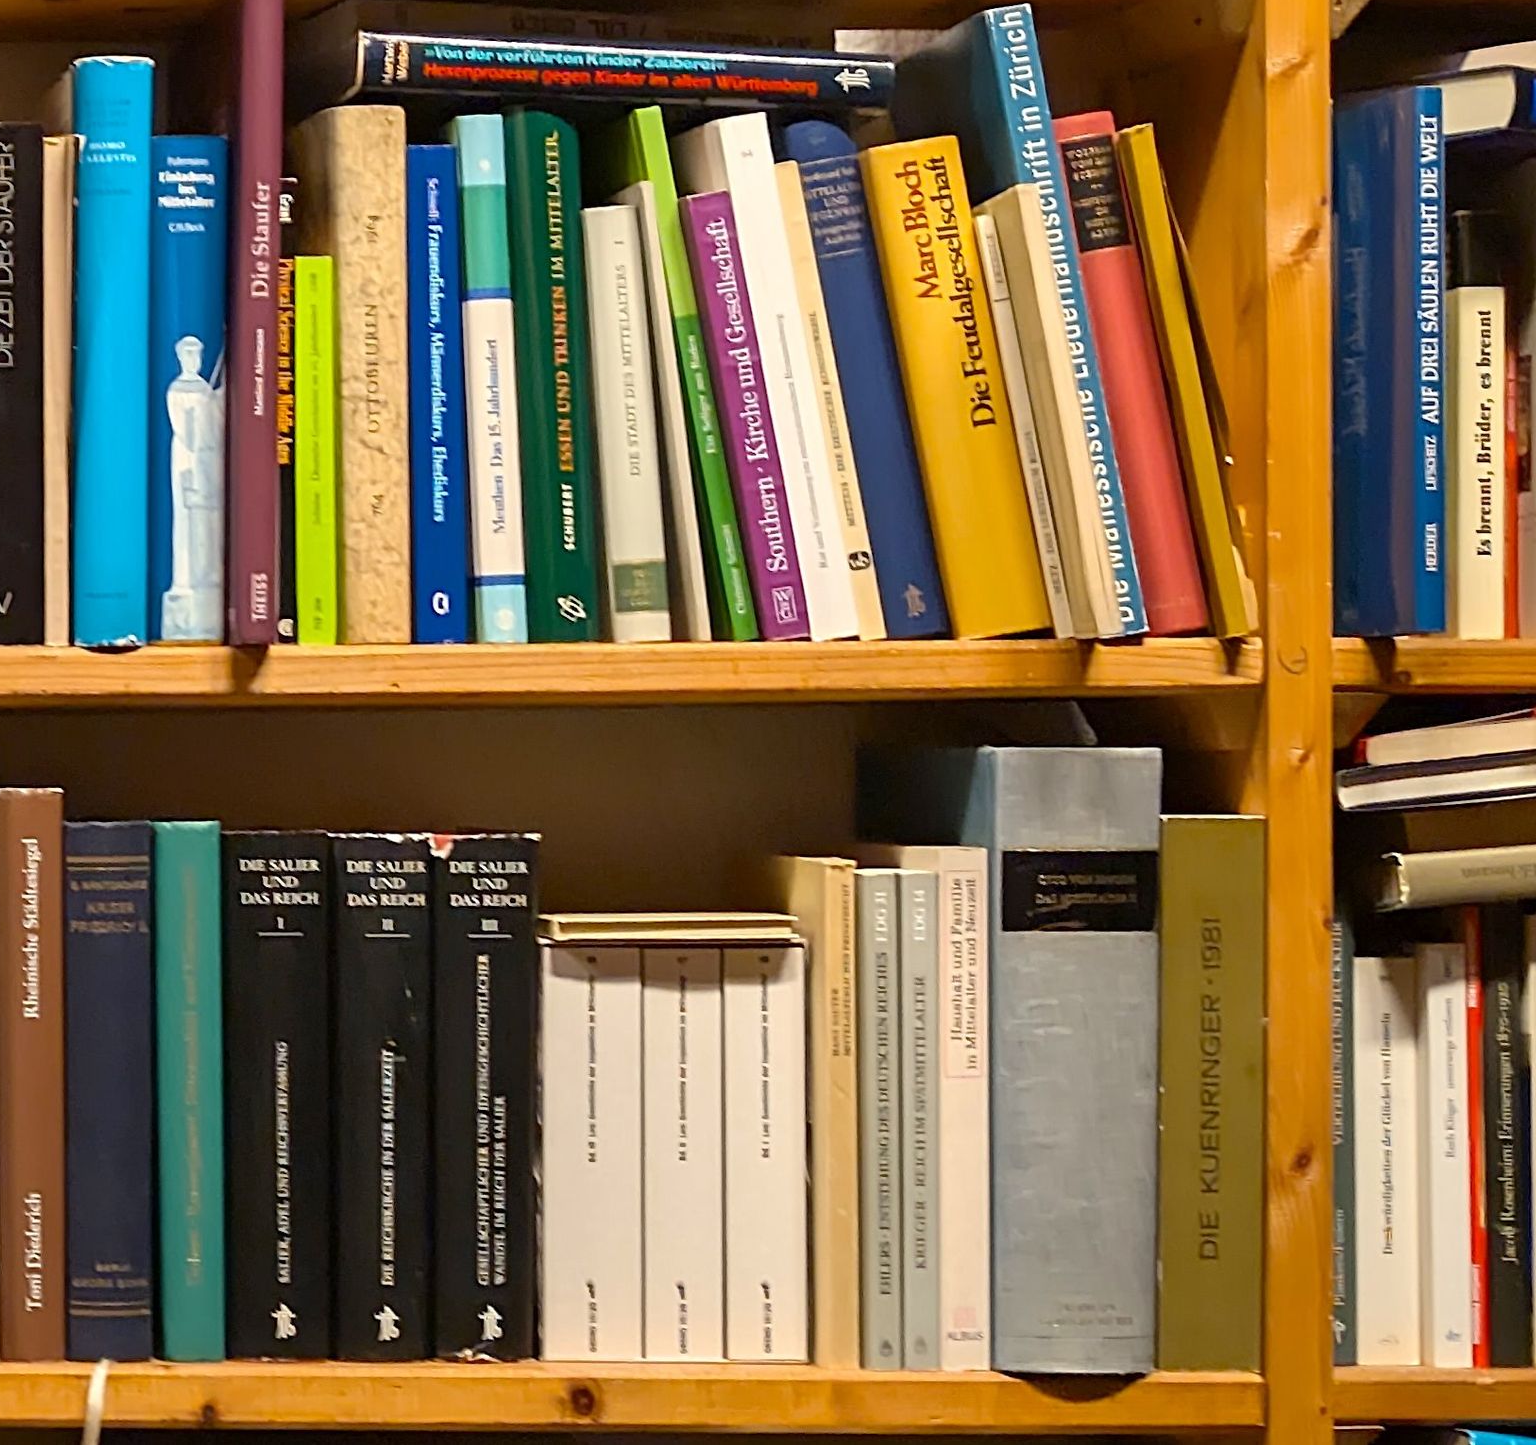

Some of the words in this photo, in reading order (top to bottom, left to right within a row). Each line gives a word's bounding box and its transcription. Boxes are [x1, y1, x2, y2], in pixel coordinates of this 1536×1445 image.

[1418, 114, 1438, 162] WELT
[895, 159, 930, 232] Bloch
[1419, 166, 1438, 199] DIE
[1418, 202, 1439, 255] RUHT
[705, 217, 752, 344] Gesellschaft
[910, 234, 943, 300] Marc
[926, 155, 989, 379] Feudalgesellschaft
[1414, 258, 1440, 332] SÄULEN
[732, 346, 759, 388] und
[1419, 337, 1440, 373] DREI
[1472, 309, 1492, 367] brennt
[964, 379, 998, 427] Die
[1419, 377, 1440, 425] AUF
[1476, 373, 1493, 390] es
[738, 392, 771, 462] Kirche
[1473, 397, 1496, 464] Brüder,
[748, 476, 792, 572] Southern
[1473, 470, 1497, 534] brennt,
[1424, 523, 1438, 572] HERDER
[1476, 539, 1494, 557] Es
[19, 837, 43, 929] Städtesiegel
[1199, 916, 1221, 970] 1981
[20, 933, 41, 1019] Rheinische
[1198, 993, 1222, 1194] KUENRINGER
[23, 1192, 43, 1268] Diederich
[1198, 1211, 1221, 1261] DIE
[24, 1273, 43, 1311] Toni
